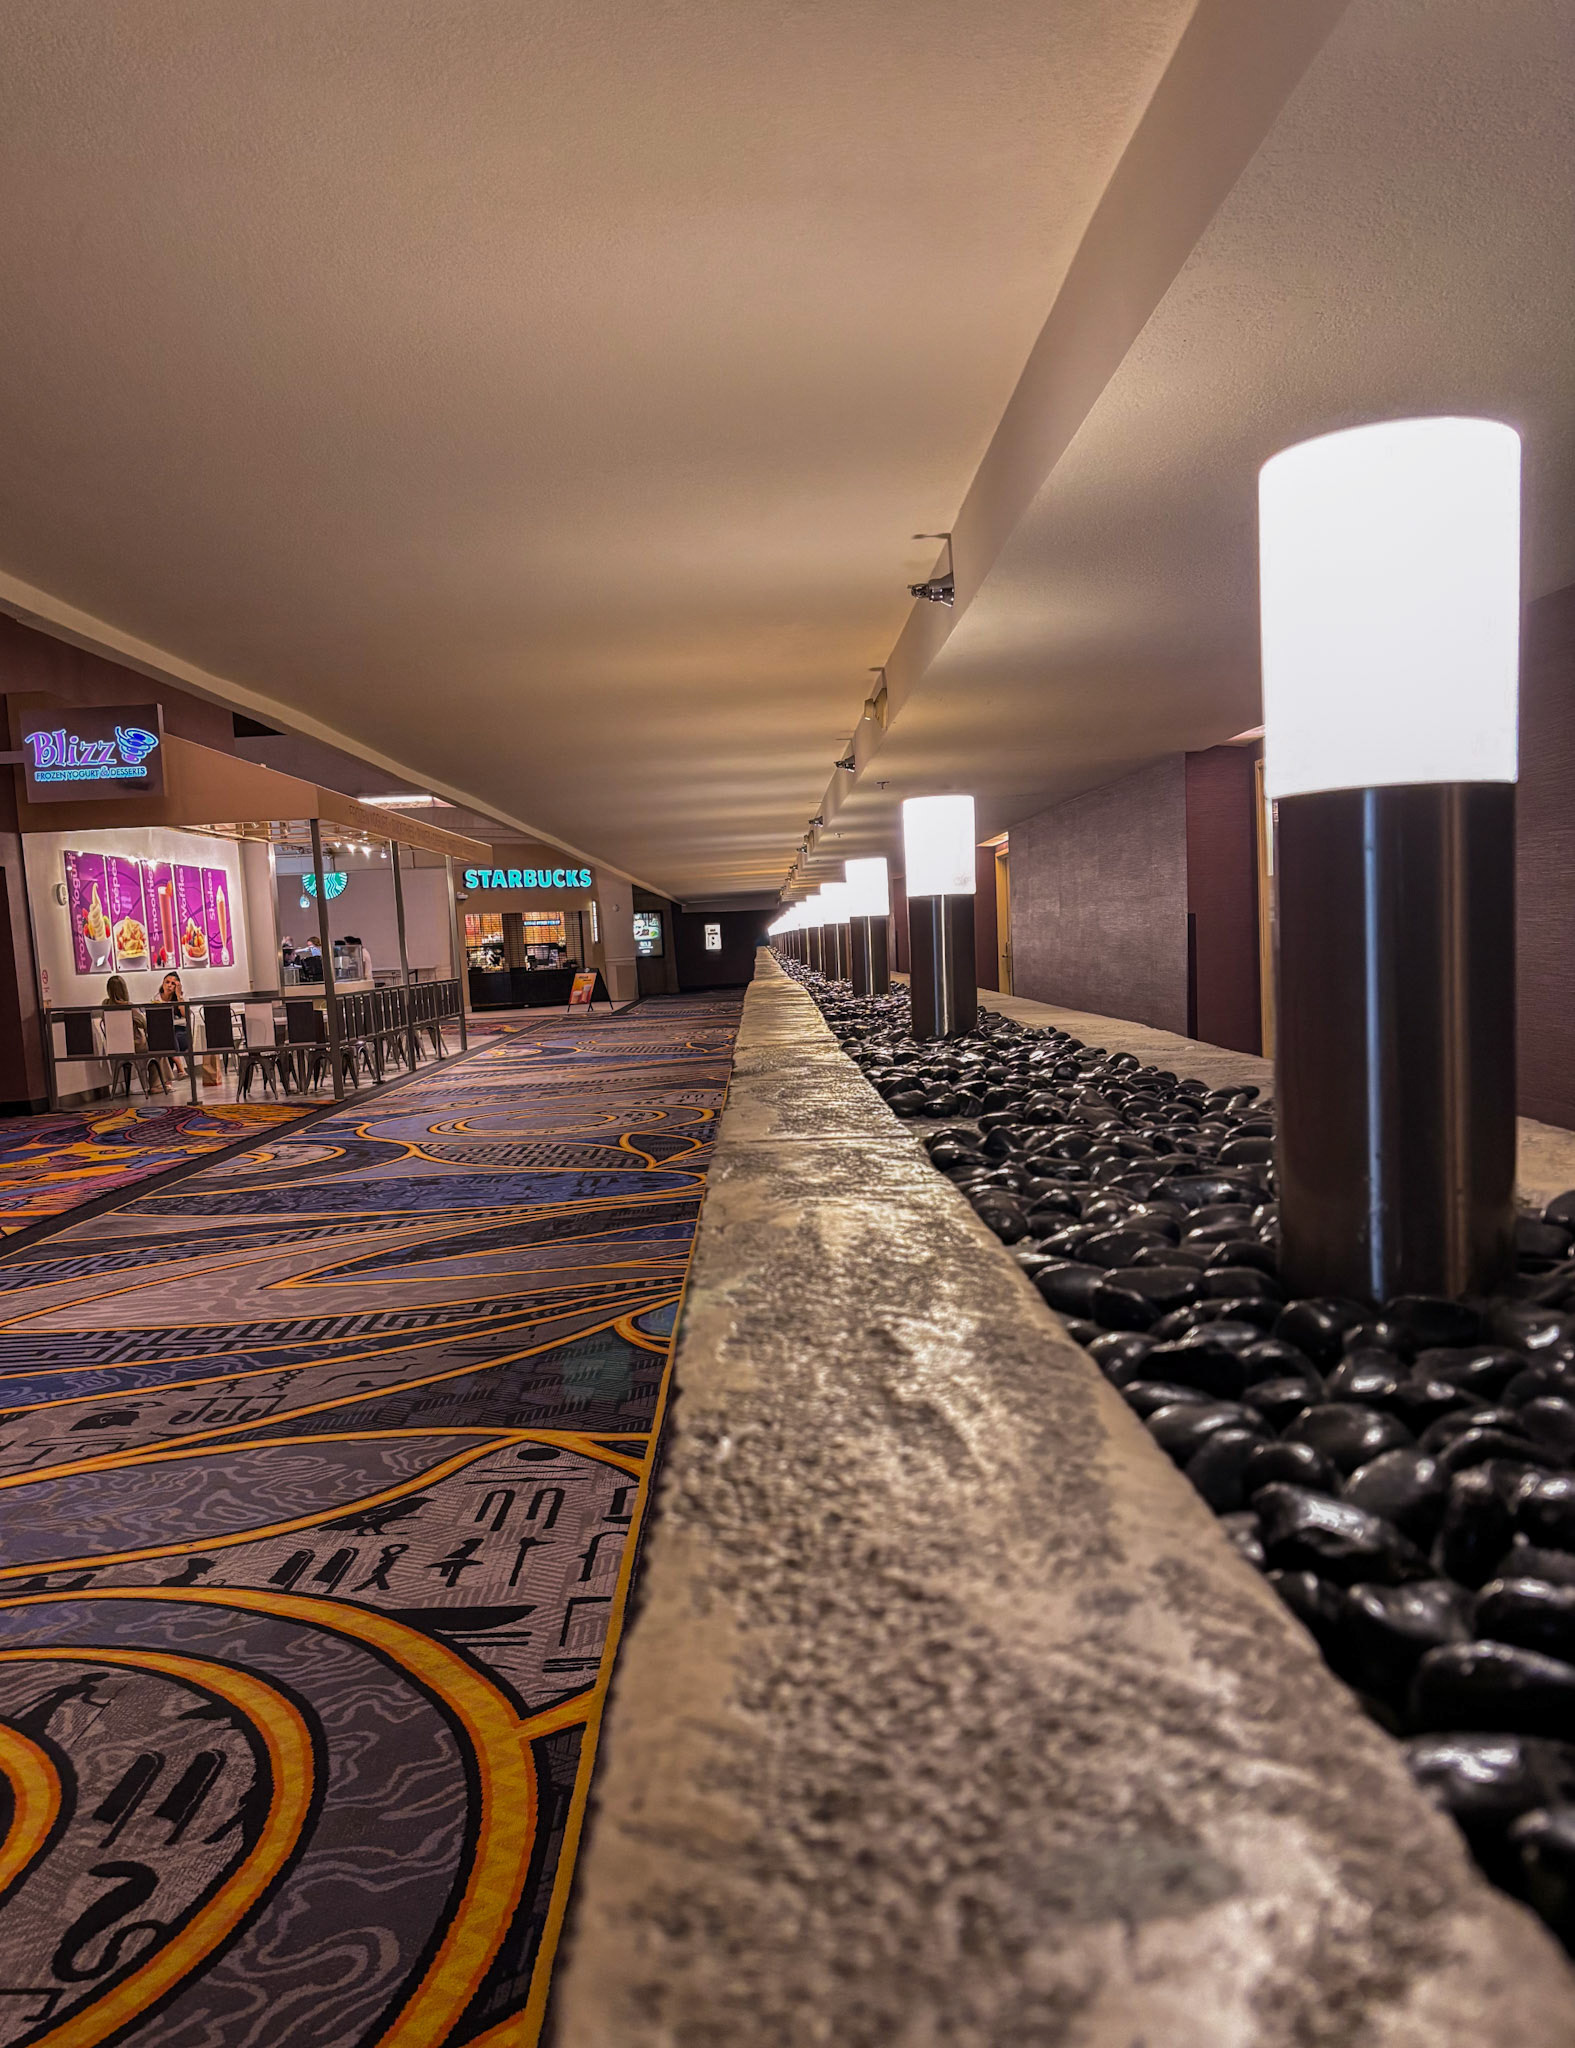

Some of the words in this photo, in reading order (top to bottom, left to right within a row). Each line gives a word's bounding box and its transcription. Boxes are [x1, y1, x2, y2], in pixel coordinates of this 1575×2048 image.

[25, 728, 117, 767] Blizz
[35, 770, 66, 781] FROZEN
[67, 769, 99, 779] YOGURT
[100, 765, 109, 778] &
[110, 766, 146, 777] DESSERTS
[69, 854, 80, 908] Yogurt
[178, 868, 188, 923] Waffles
[207, 871, 216, 921] Shakes
[465, 868, 592, 889] STARBUCKS
[76, 914, 87, 970] Frozen
